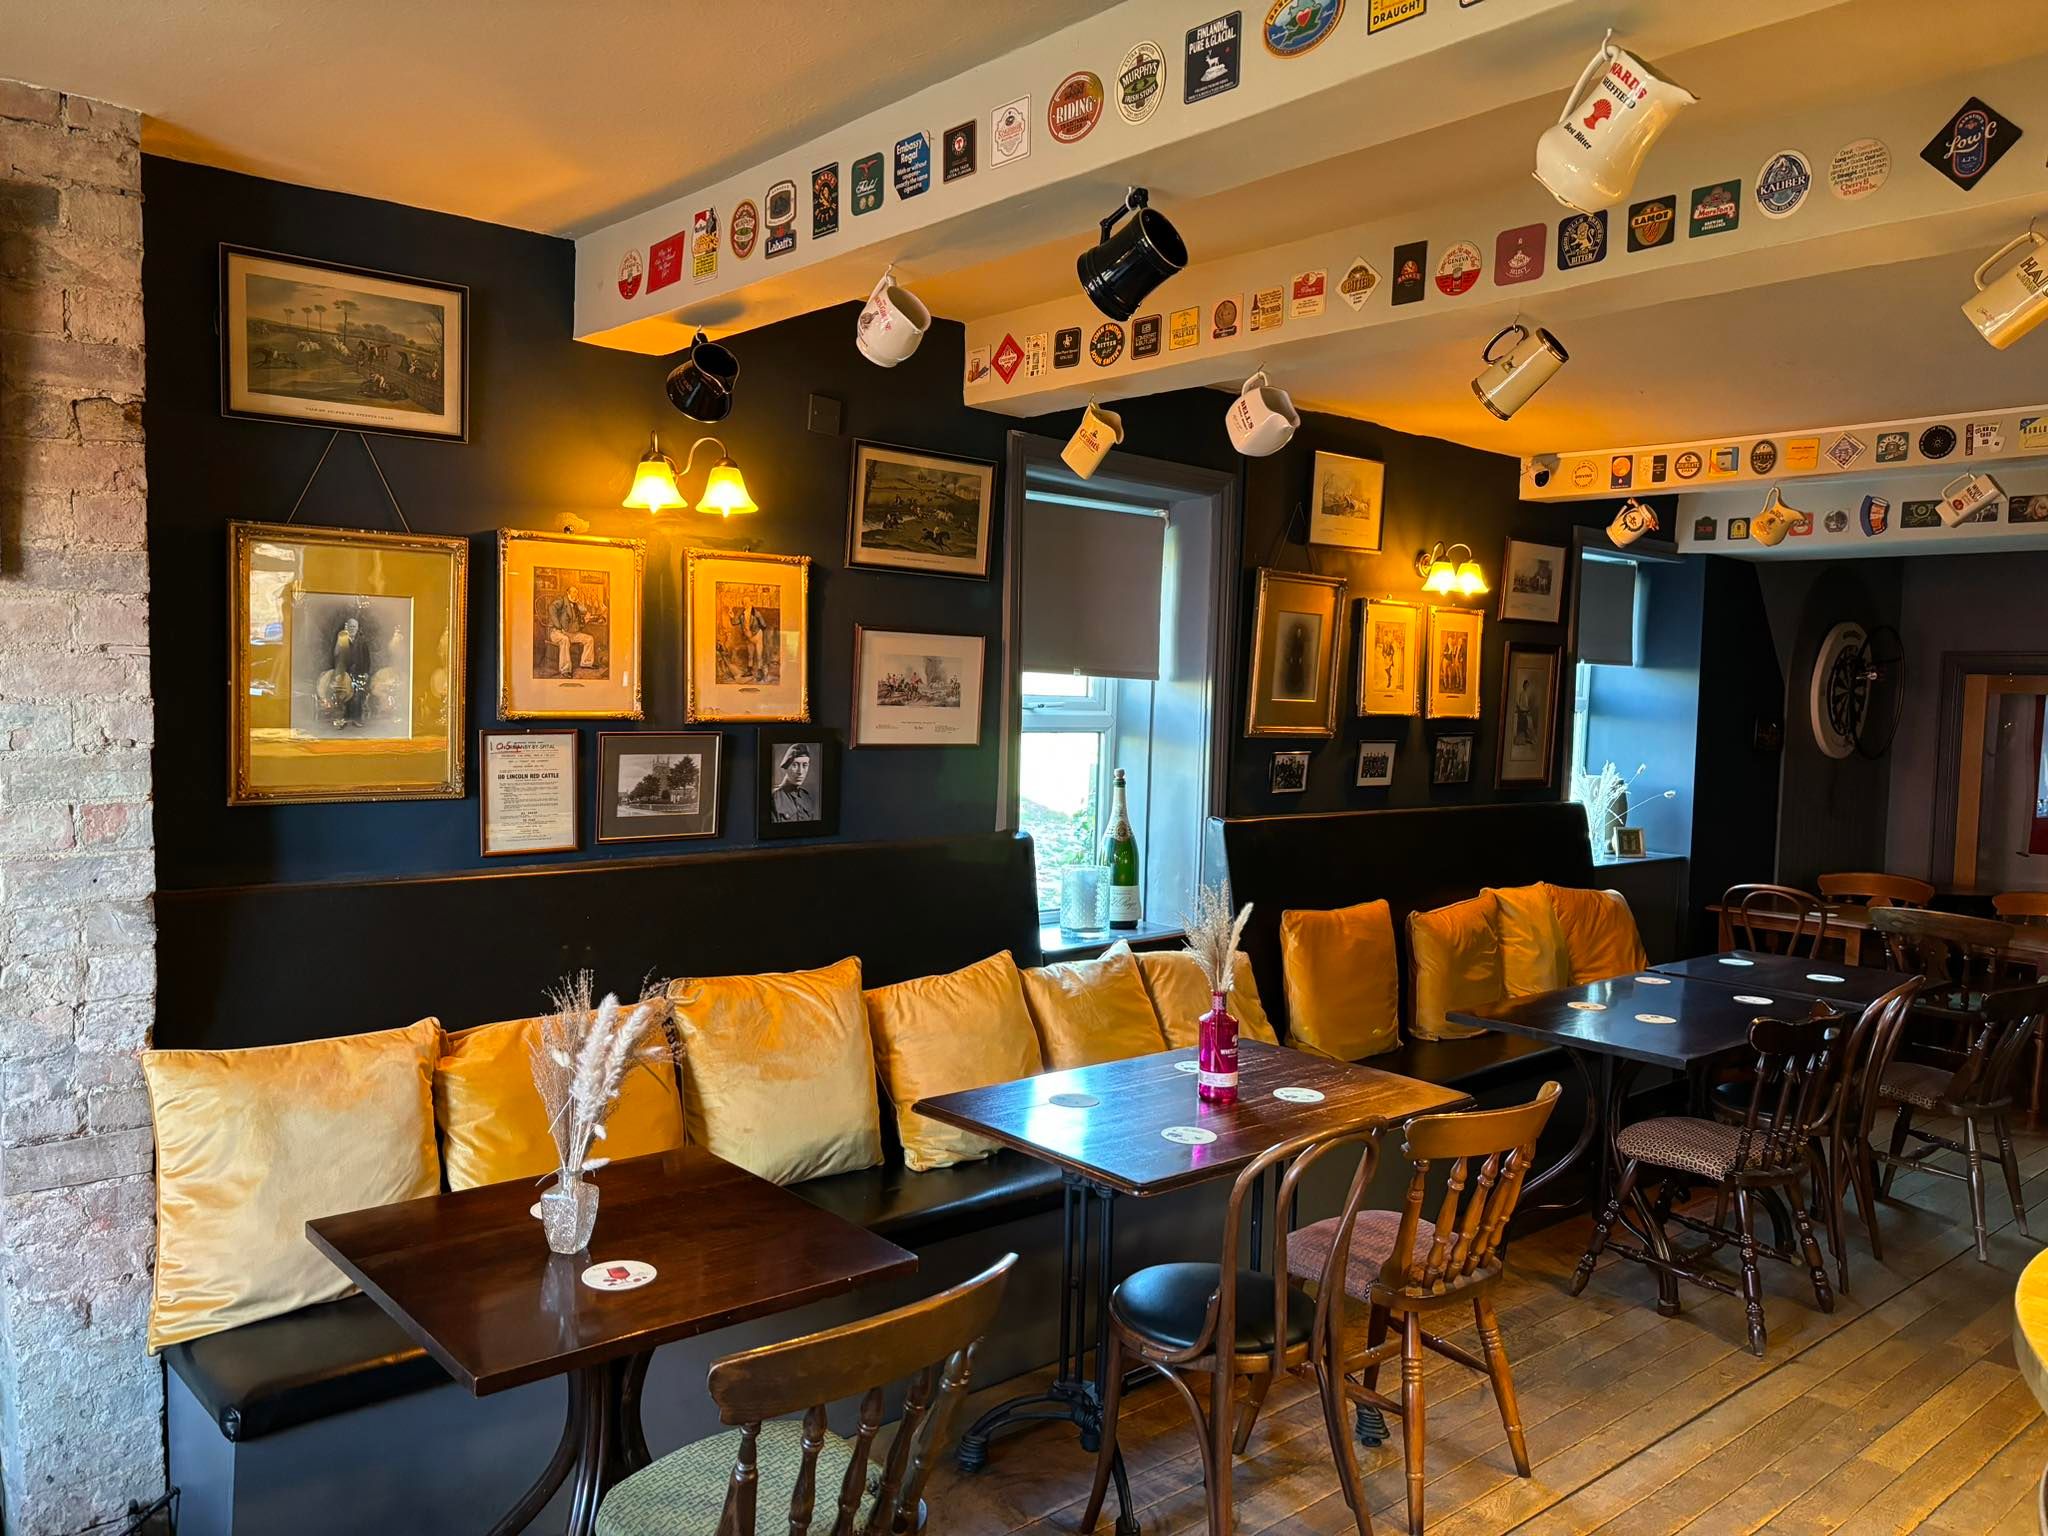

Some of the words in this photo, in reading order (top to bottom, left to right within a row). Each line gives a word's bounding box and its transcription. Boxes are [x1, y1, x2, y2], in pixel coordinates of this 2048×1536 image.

[1373, 0, 1420, 25] DRAUGHT
[1189, 41, 1205, 55] PURE
[1205, 38, 1211, 49] &
[1139, 84, 1157, 100] STOUT
[1056, 96, 1093, 124] RIDING
[1564, 122, 1576, 138] Best
[1573, 130, 1593, 151] Bitter
[1944, 132, 1982, 160] Low
[1984, 121, 1998, 138] C
[896, 138, 923, 155] Embassy
[900, 149, 918, 164] Regal
[1834, 156, 1847, 164] Long
[1760, 175, 1806, 196] KALIBER
[1840, 180, 1863, 192] Cherry
[1698, 205, 1735, 217] Marston's
[768, 235, 793, 254] Labatt's
[1447, 256, 1469, 266] GENEVA
[1571, 253, 1594, 265] BITTER
[1509, 265, 1528, 275] SELECT
[1097, 340, 1117, 349] BITTER
[1240, 399, 1255, 430] BELL'S
